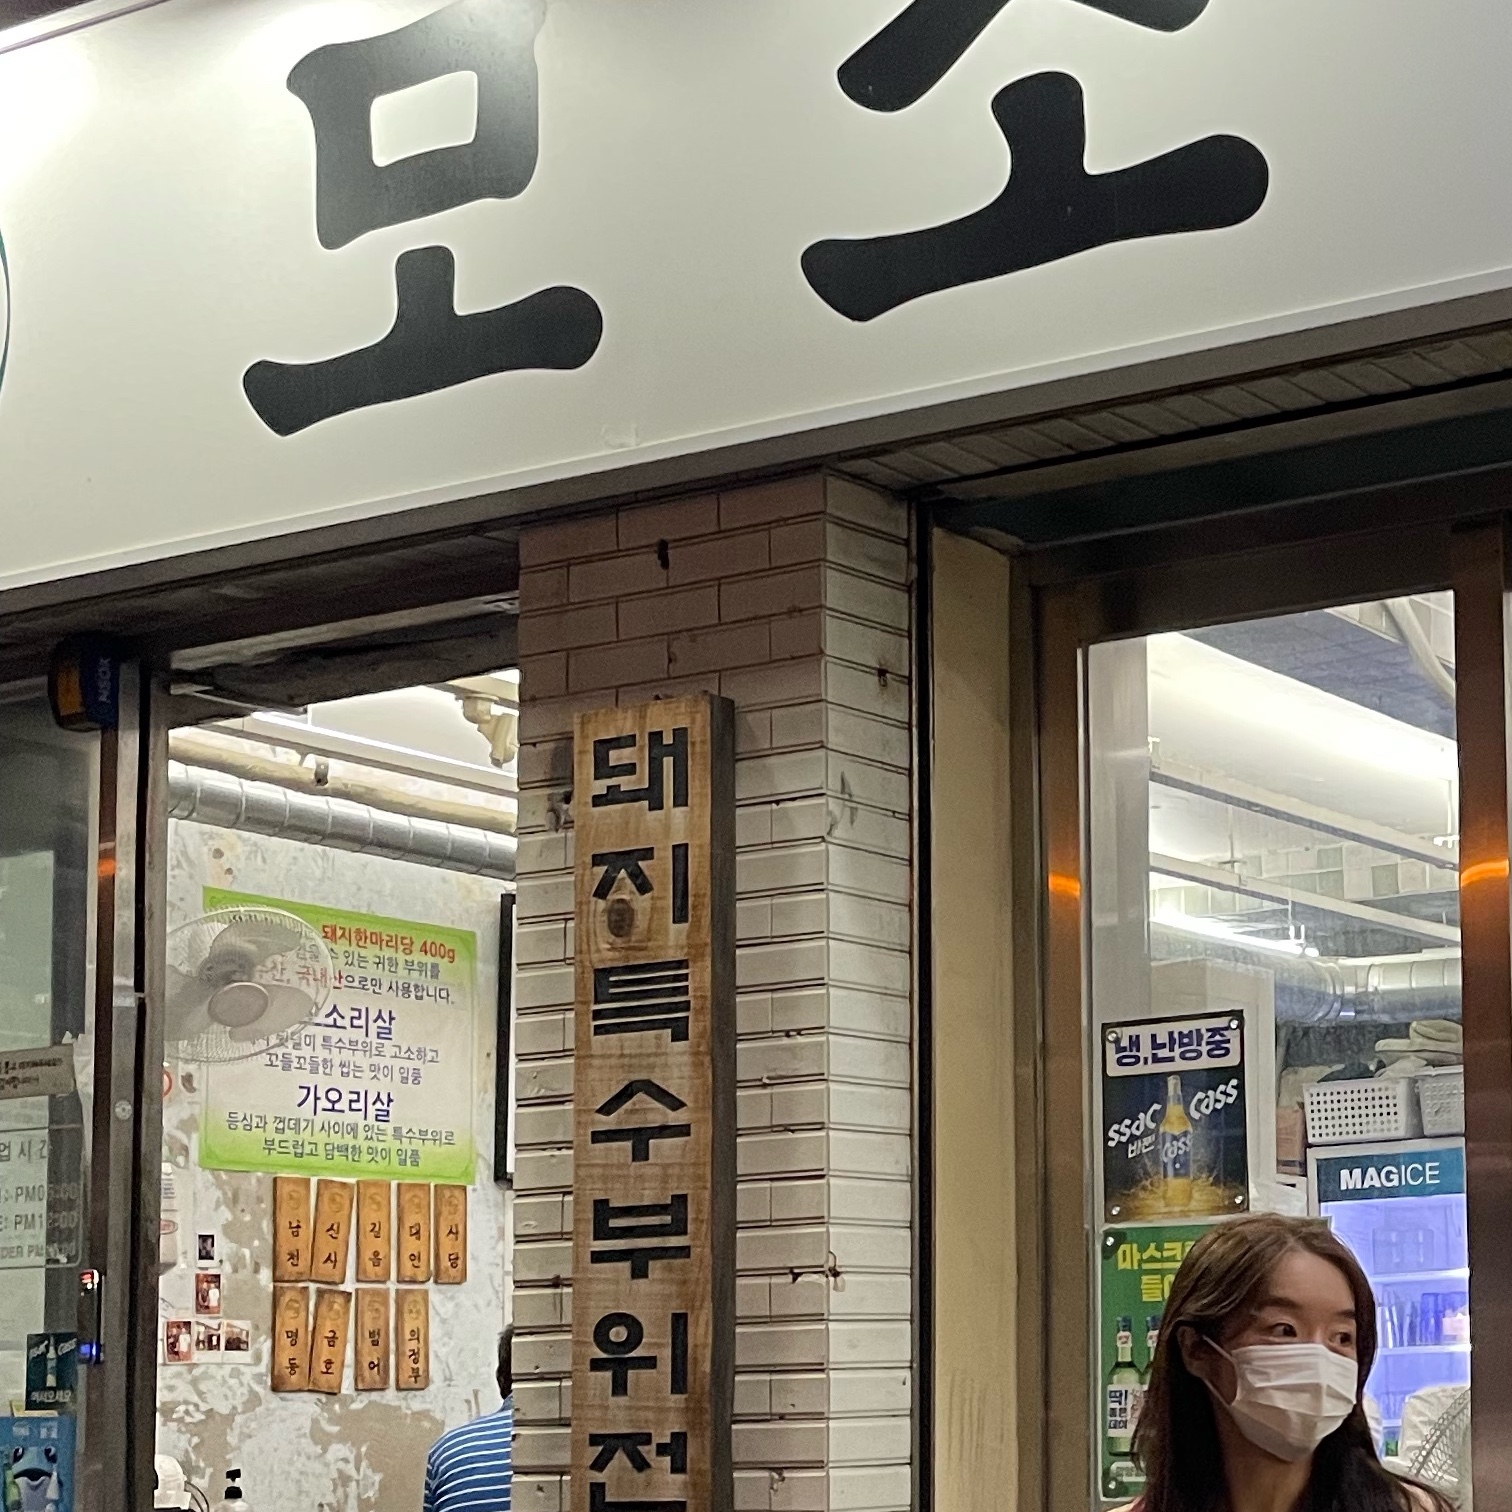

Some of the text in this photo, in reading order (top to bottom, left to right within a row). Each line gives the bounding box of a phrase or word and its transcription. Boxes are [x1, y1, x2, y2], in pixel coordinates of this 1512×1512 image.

[322, 924, 415, 956] 돼지한마리당
[419, 940, 456, 963] 400g
[344, 950, 369, 970] 있는
[373, 954, 399, 974] 귀한
[404, 960, 441, 980] 부위를
[387, 980, 455, 1005] 사용합니다.
[320, 1035, 386, 1059] 특수부위로
[389, 1043, 440, 1065] 고소하고
[264, 1052, 334, 1076] 꼬들꼬들한
[338, 1059, 365, 1080] 씹는
[369, 1062, 394, 1082] 맛이
[297, 1084, 395, 1123] 가오리살
[226, 1111, 456, 1147] 등심과 껍데기 사이에 있는 특수부위로
[263, 1138, 421, 1168] 부드럽고 담백한 맛이 일품
[1339, 1163, 1440, 1191] MAGICE
[323, 1221, 341, 1270] 신사
[1118, 1240, 1196, 1270] 마스크
[284, 1328, 300, 1377] 명동
[320, 1329, 339, 1376] 금호
[407, 1327, 422, 1385] 의정부
